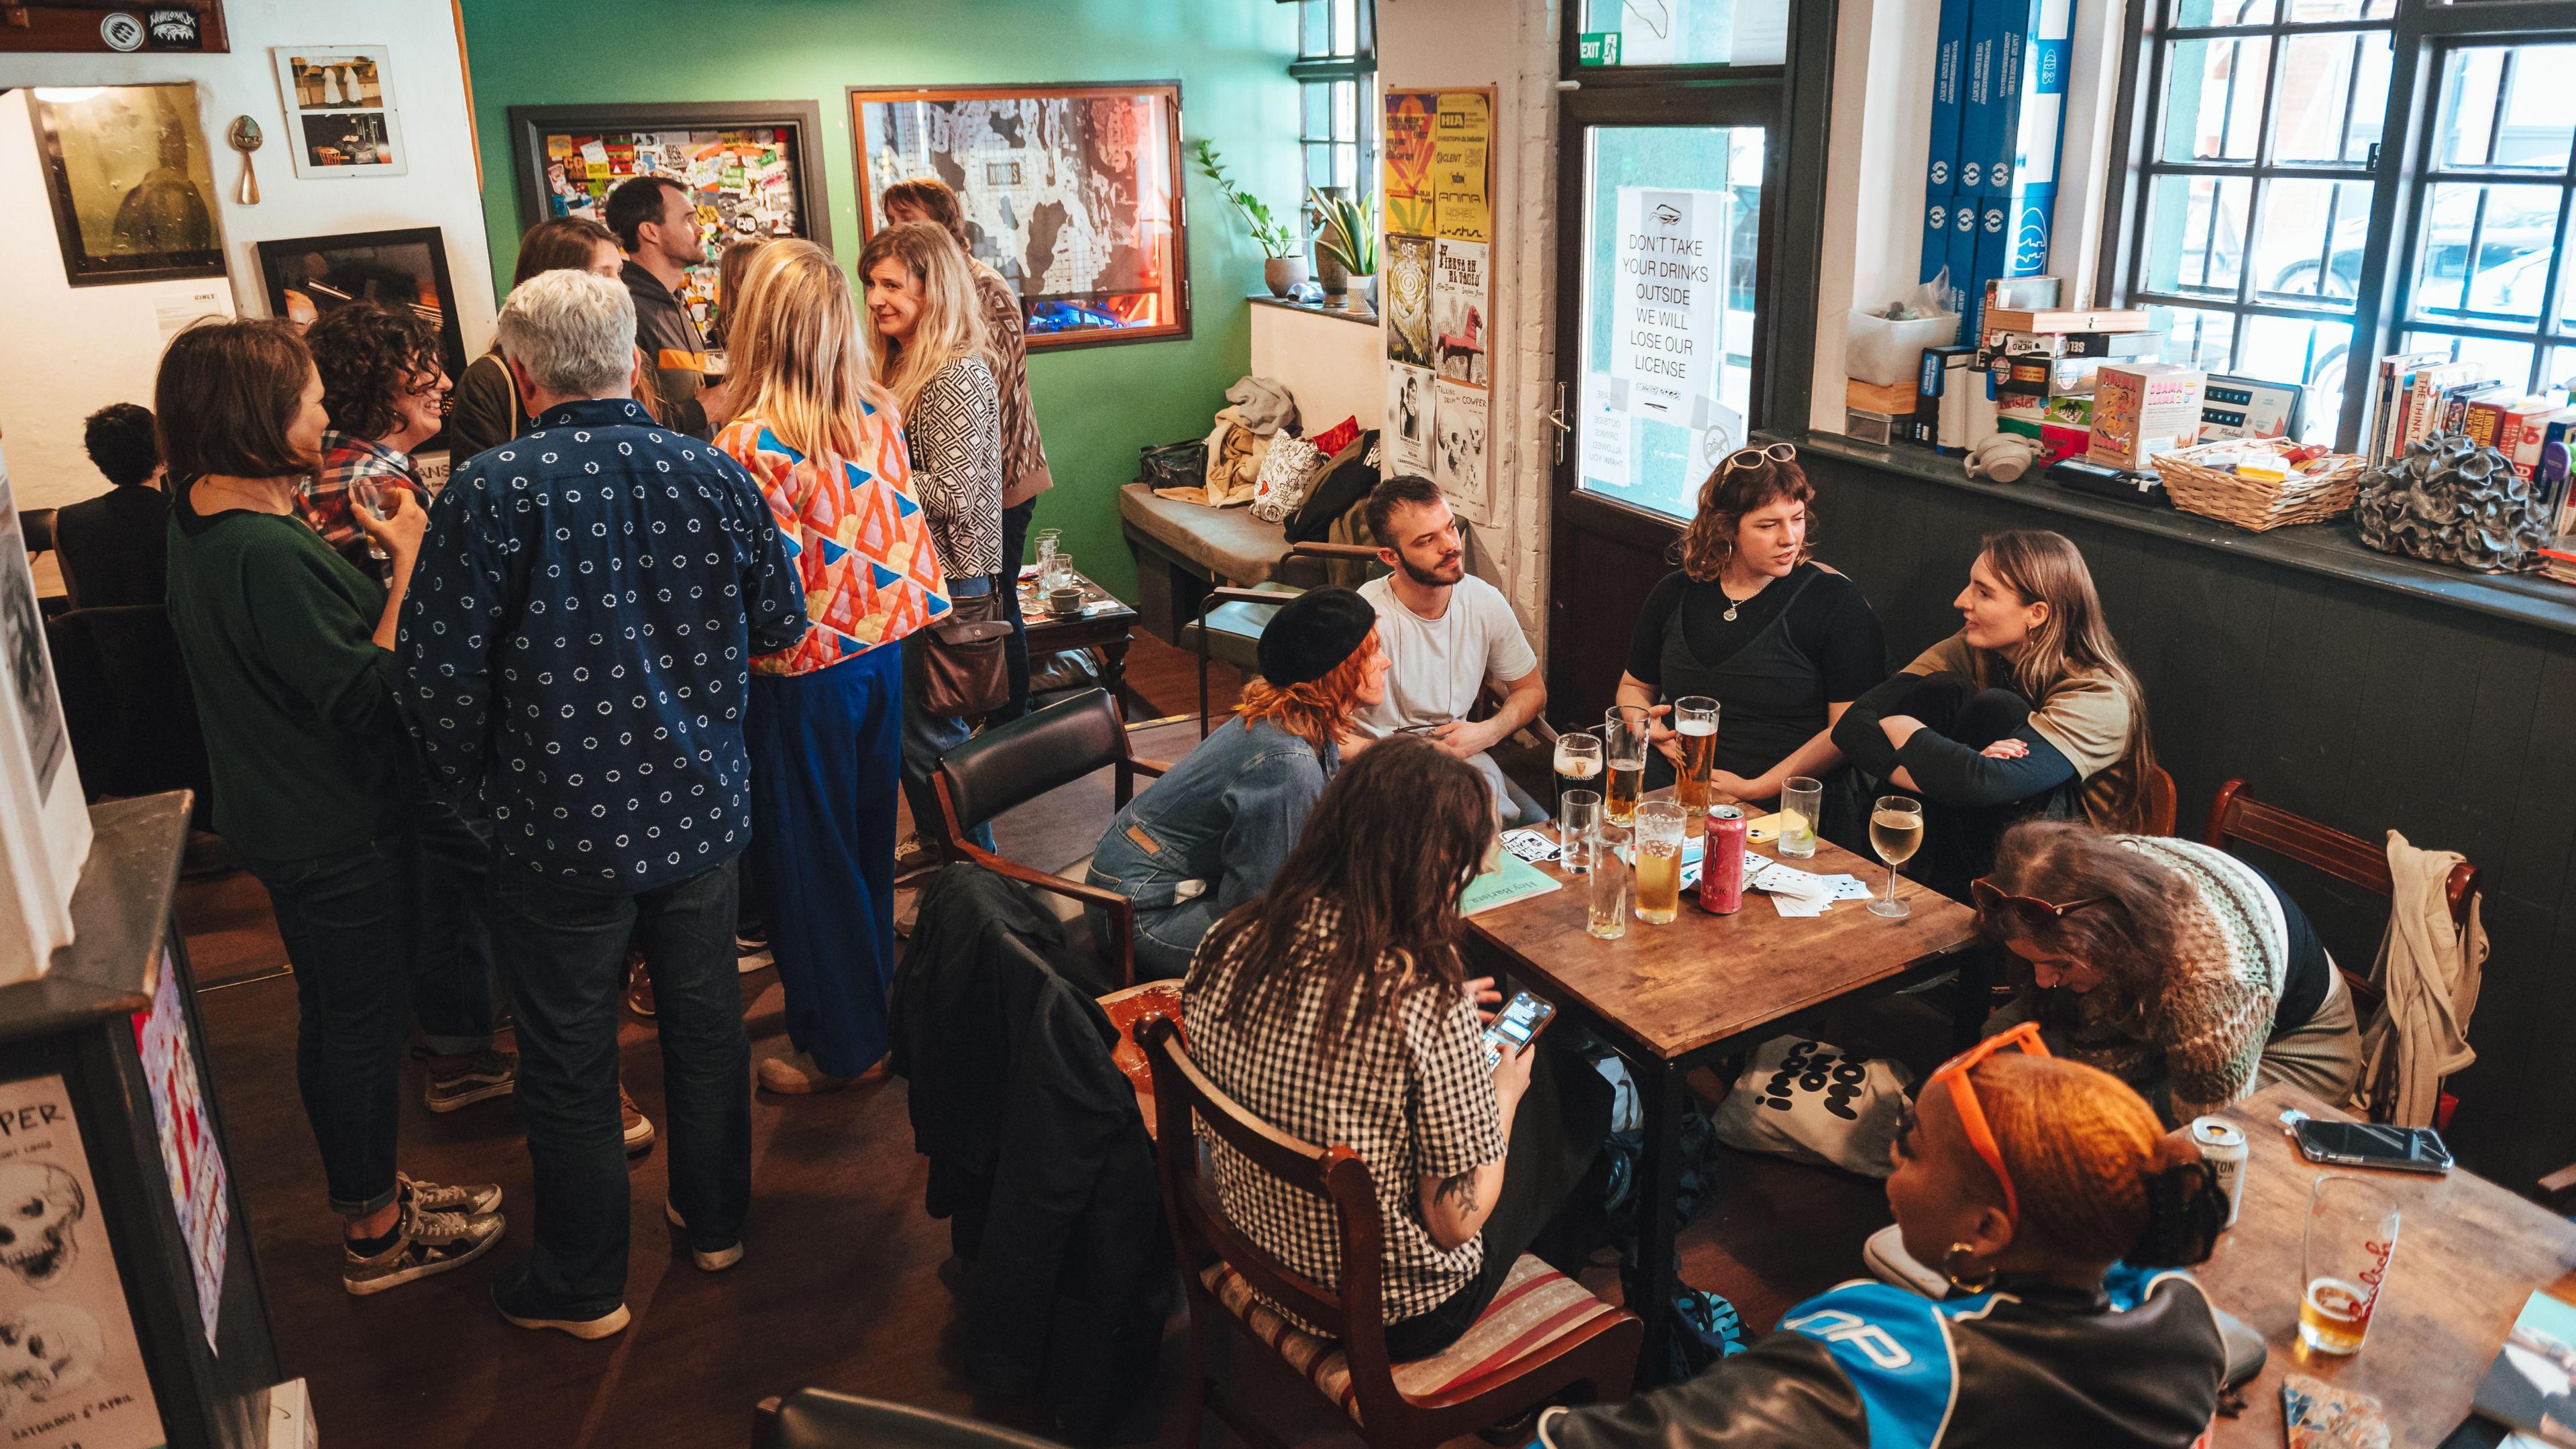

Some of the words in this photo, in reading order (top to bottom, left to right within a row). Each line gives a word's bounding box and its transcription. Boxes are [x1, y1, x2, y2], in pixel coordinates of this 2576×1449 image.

[1580, 42, 1601, 59] EXIT
[1441, 114, 1464, 126] HIA
[1629, 234, 1666, 253] DON'T
[1670, 238, 1703, 256] TAKE
[1623, 258, 1656, 276] YOUR
[1660, 262, 1708, 282] DRINKS
[1636, 283, 1690, 305] OUTSIDE
[1637, 307, 1655, 325] WE
[1659, 311, 1688, 330] WILL
[1631, 330, 1661, 350] LOSE
[1665, 336, 1693, 356] OUR
[1635, 354, 1686, 378] LICENSE
[2416, 378, 2428, 398] THE
[1462, 396, 1487, 408] COWPER
[2410, 402, 2424, 433] THINK
[2464, 407, 2475, 436] CRICK
[2474, 409, 2487, 426] WEST
[2481, 415, 2496, 441] HISTORY
[2218, 427, 2246, 439] Pinball
[1562, 773, 1595, 782] GUINNESS
[1513, 880, 1537, 897] Hey
[0, 1104, 66, 1136] PER
[2214, 1160, 2237, 1174] TON
